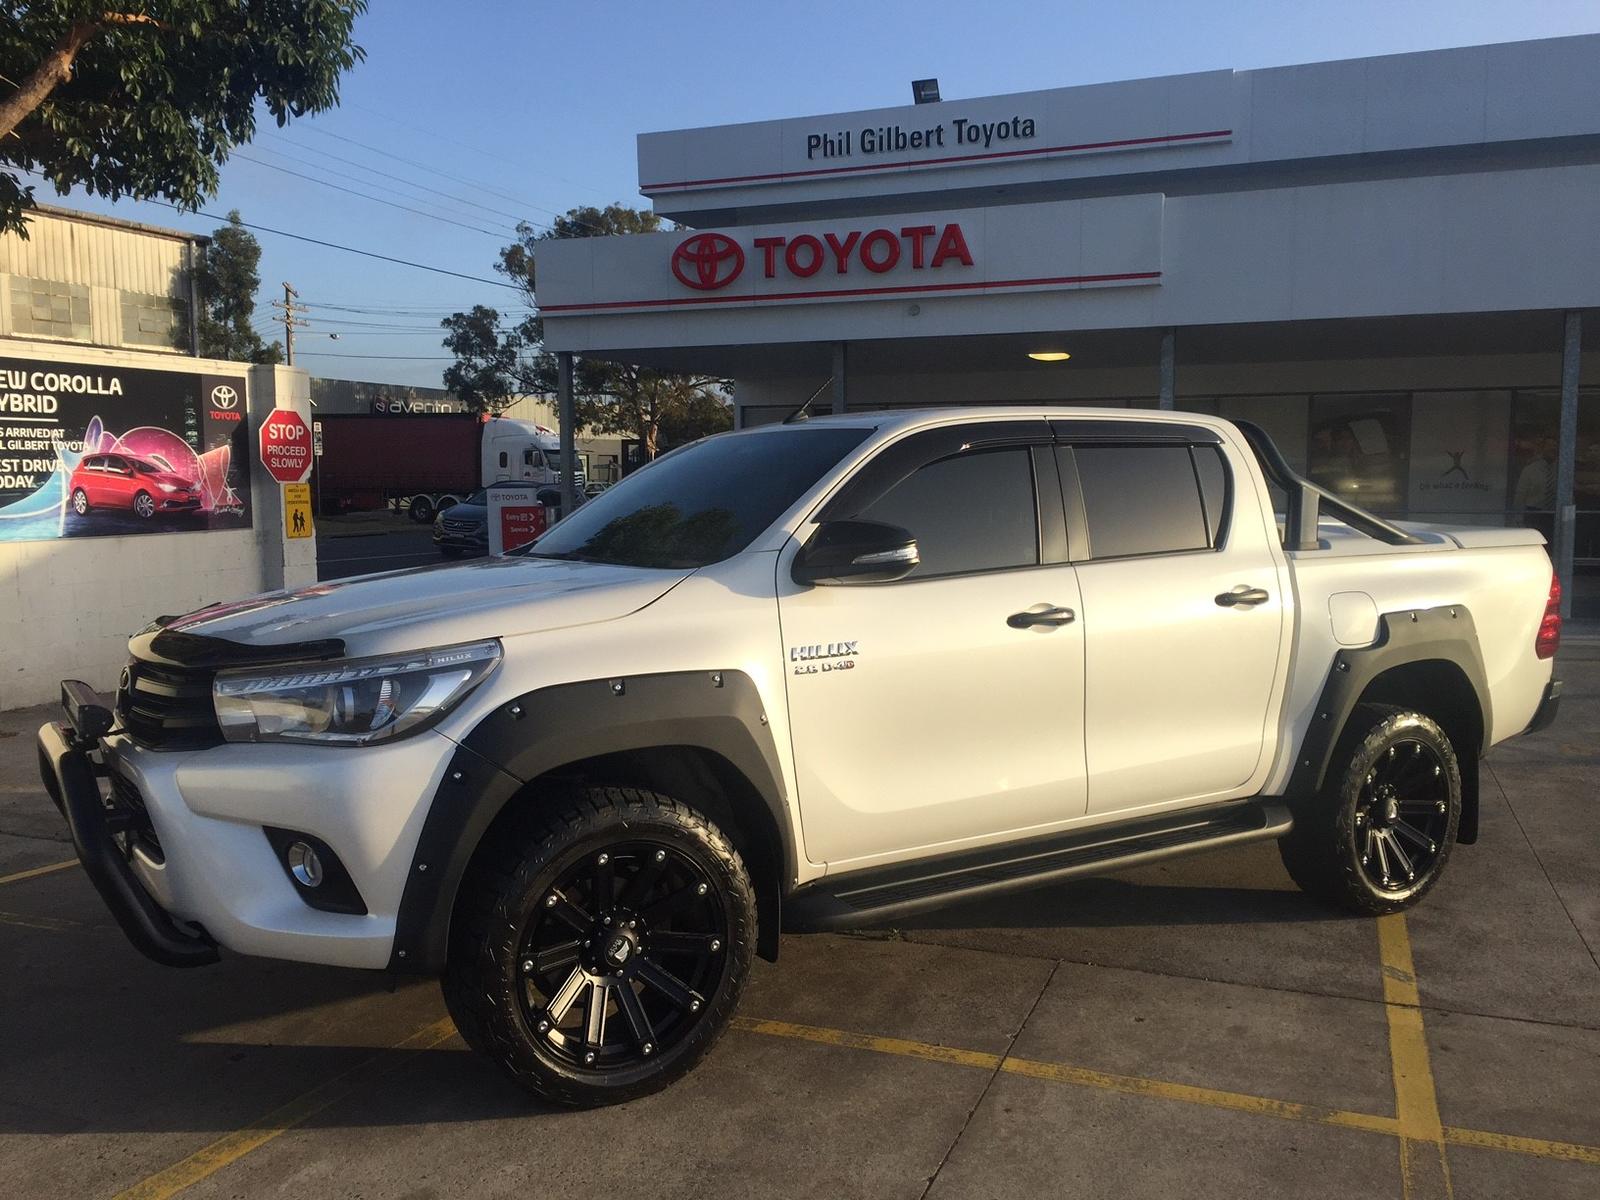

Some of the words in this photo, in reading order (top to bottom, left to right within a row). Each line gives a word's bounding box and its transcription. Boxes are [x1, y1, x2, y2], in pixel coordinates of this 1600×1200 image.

[807, 131, 851, 160] Phil
[860, 124, 944, 154] Gilbert
[953, 115, 1036, 148] Toyota
[753, 223, 974, 279] TOYOTA
[30, 372, 123, 395] COROLLA
[209, 410, 242, 421] TOYOTA
[5, 427, 51, 439] ARRIVED
[51, 428, 65, 439] AT
[269, 423, 304, 440] STOP
[7, 440, 50, 451] GILBERT
[51, 441, 90, 452] TOYOTA
[267, 445, 307, 456] PROCEED
[0, 459, 20, 473] ST
[22, 459, 64, 473] DRIVE
[271, 457, 304, 468] SLOWLY
[437, 652, 472, 663] HILUX
[790, 640, 860, 662] HILUX
